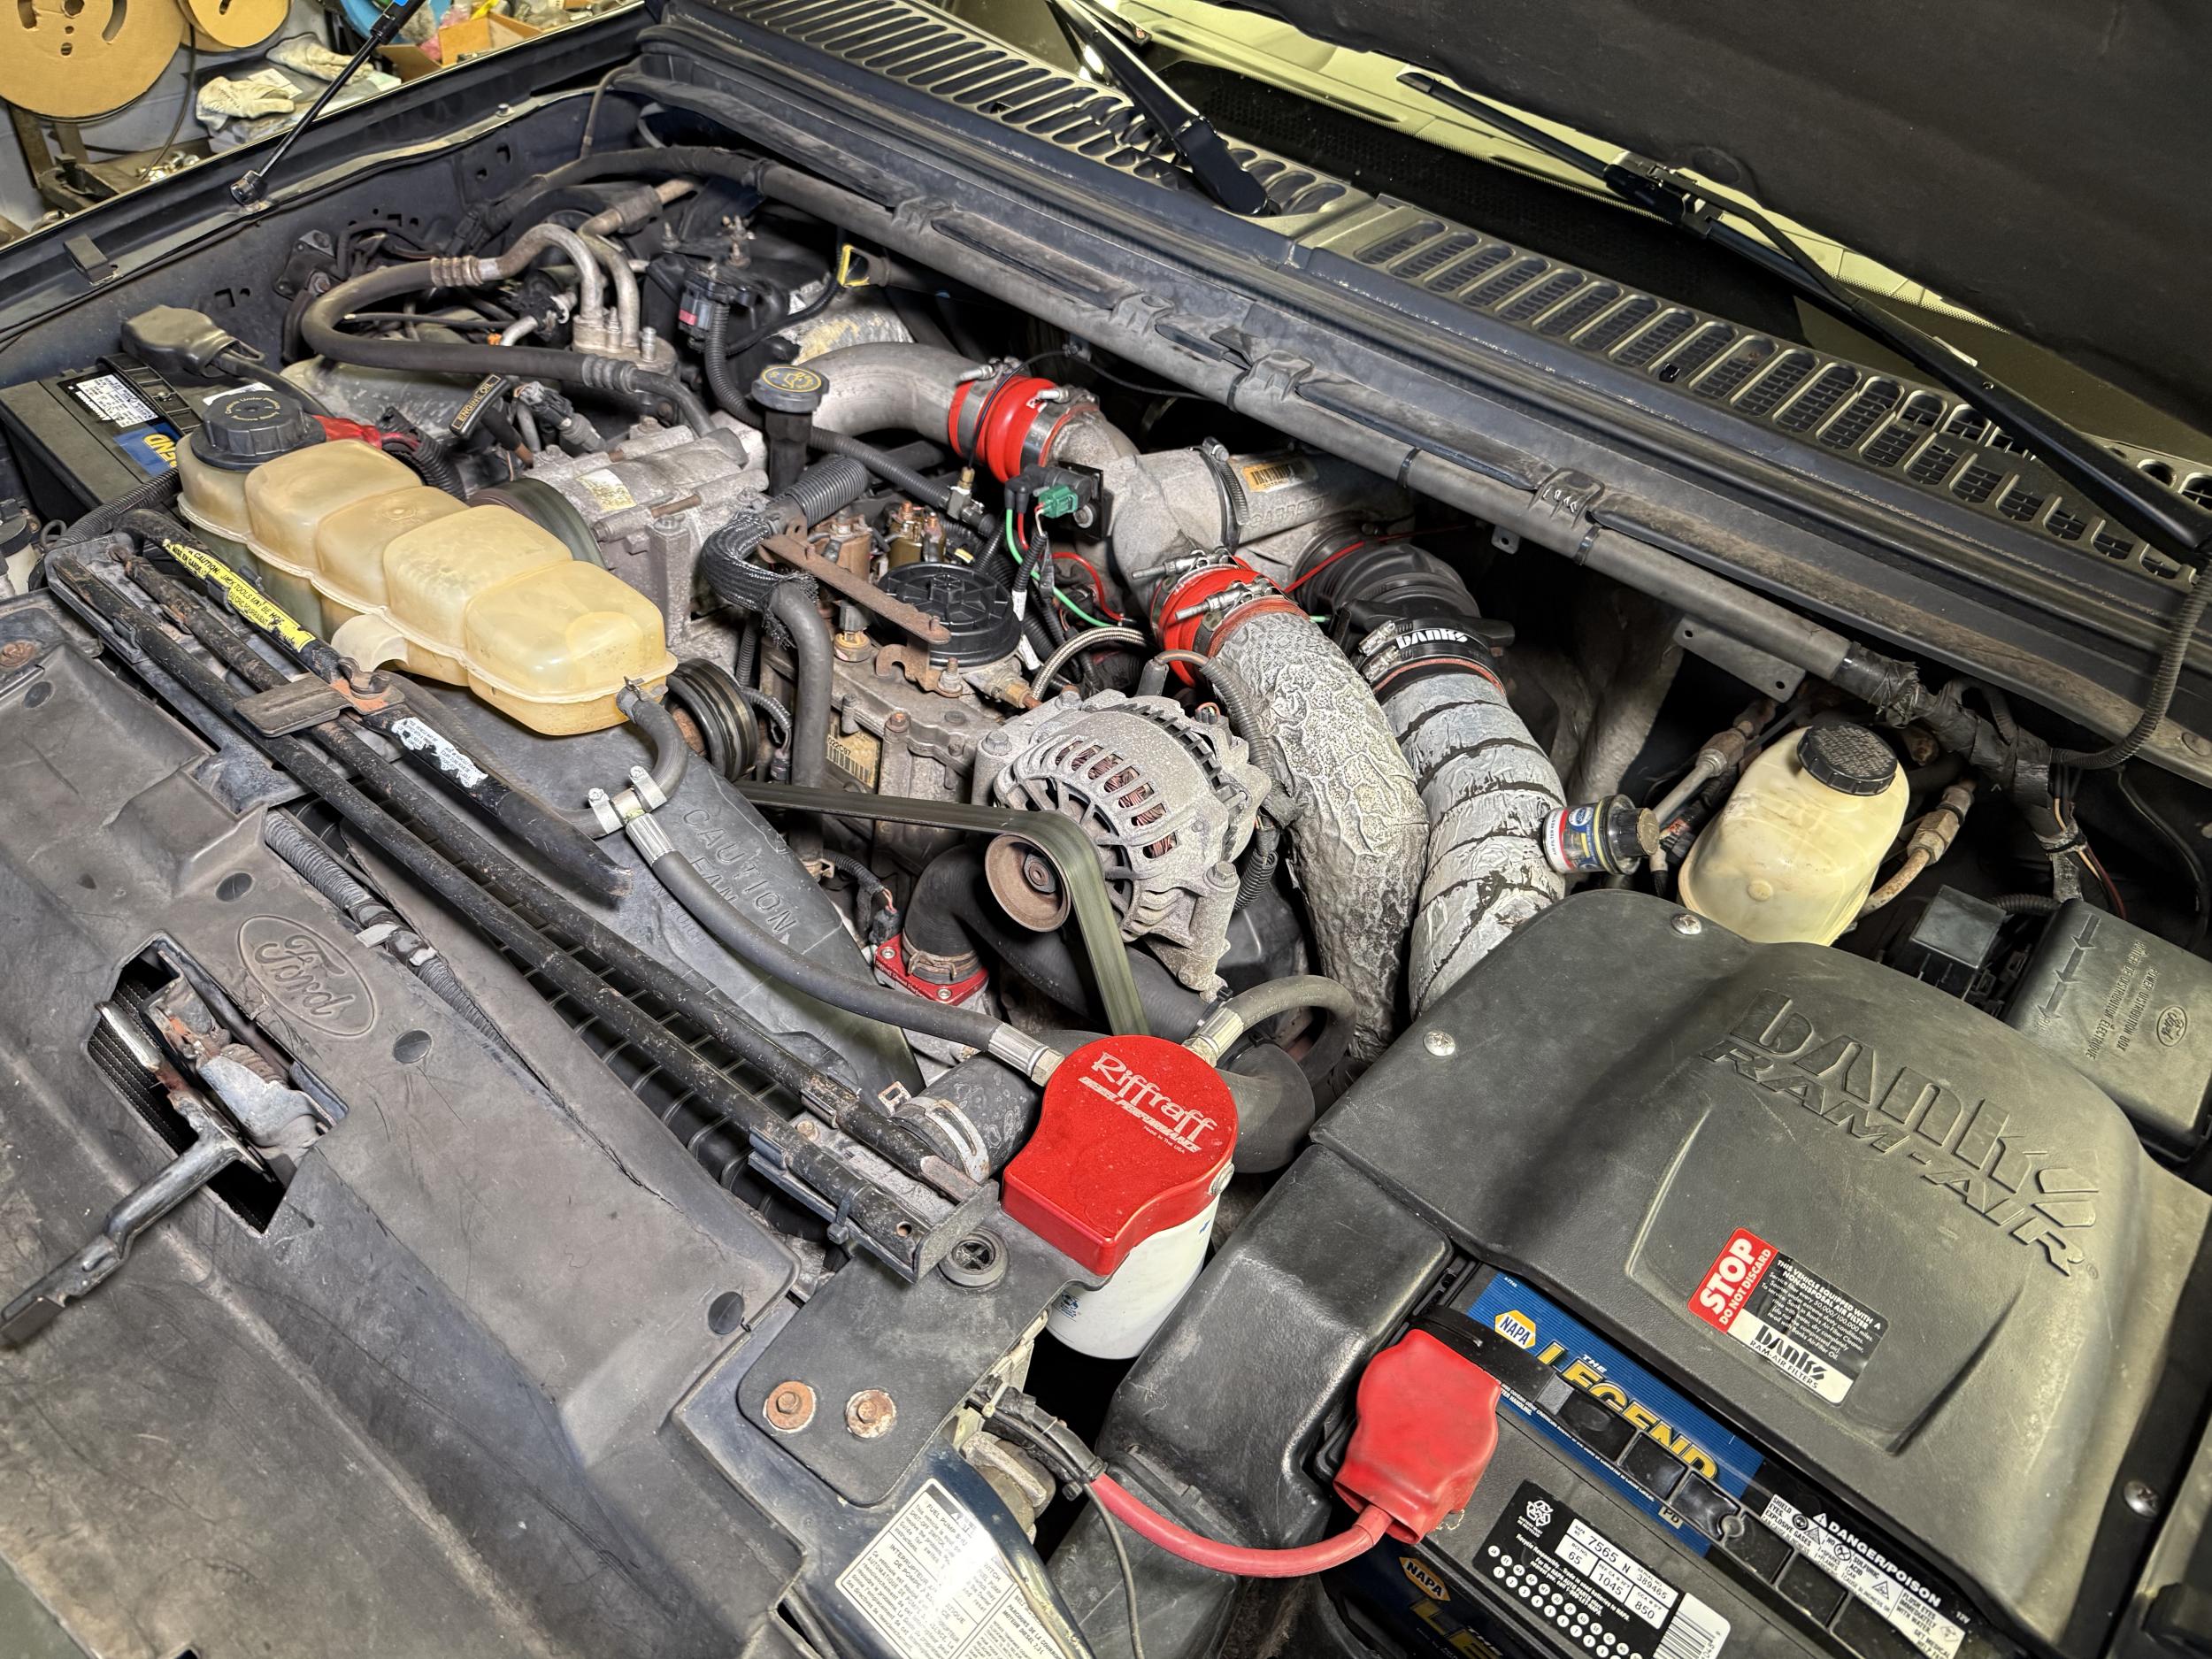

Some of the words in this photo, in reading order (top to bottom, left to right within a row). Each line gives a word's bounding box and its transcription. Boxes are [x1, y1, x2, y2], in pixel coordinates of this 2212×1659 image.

[480, 382, 495, 396] OIL
[220, 572, 234, 588] JACK
[234, 582, 251, 600] TOOLS
[261, 603, 270, 615] BE
[683, 809, 797, 934] CAUTION
[254, 934, 355, 1016] Ford
[2140, 966, 2162, 992] POWER
[2101, 975, 2131, 1018] DISTRIBUTION
[2119, 990, 2151, 1035] DISTRIBUTION
[2160, 1010, 2185, 1041] Ford
[2114, 1034, 2131, 1051] BOX
[1091, 1051, 1218, 1141] Riffraff
[1174, 1142, 1186, 1154] USA
[1699, 1039, 2086, 1277] RAM-AIR
[1699, 1238, 1755, 1315] STOP
[1719, 1309, 1731, 1325] DO
[1728, 1287, 1747, 1309] NOT
[1740, 1248, 1771, 1289] DISCARD
[1768, 1271, 1788, 1286] Service
[1797, 1291, 1814, 1304] every
[1812, 1299, 1860, 1333] 50,000/100,000
[1776, 1258, 1793, 1272] THIS
[1791, 1269, 1819, 1290] VEHICLE
[1818, 1286, 1854, 1312] EQUIPPED
[1852, 1307, 1874, 1324] WITH
[1873, 1322, 1881, 1331] A
[1780, 1271, 1835, 1308] NON-DISPOSAL
[1832, 1303, 1847, 1315] AIR
[1845, 1311, 1869, 1330] FILTER
[1786, 1291, 1803, 1304] under
[1801, 1301, 1824, 1317] extreme
[1822, 1313, 1838, 1326] dusty
[1499, 1315, 1532, 1346] NAPA
[1784, 1305, 1796, 1316] with
[1809, 1323, 1821, 1333] dry
[1819, 1329, 1850, 1352] completely
[1791, 1326, 1808, 1340] Banks
[1805, 1310, 1822, 1325] Banks
[1799, 1324, 1831, 1347] compressed
[1582, 1354, 1608, 1373] THE
[1749, 1340, 1786, 1368] RAM-AIR
[1787, 1364, 1818, 1389] FILTERS
[1508, 1395, 1533, 1416] HANDLING.
[1535, 1340, 1718, 1480] LEGEND
[926, 1502, 941, 1519] FUEL
[939, 1517, 956, 1534] PUMP
[1771, 1496, 1793, 1514] SHIELD
[899, 1520, 913, 1535] Guide
[1764, 1509, 1793, 1533] EXPLOSIVE
[1793, 1530, 1812, 1547] GASES
[1825, 1536, 1835, 1546] NO
[888, 1543, 929, 1586] INTERRUPTEUR
[1567, 1551, 1583, 1565] 65
[1586, 1535, 1619, 1563] 7565
[1828, 1521, 1941, 1608] DANGER/POISON
[866, 1555, 899, 1589] AUTOMATIQUE
[896, 1587, 905, 1596] DE
[893, 1558, 903, 1569] DE
[900, 1567, 922, 1589] POMPE
[1406, 1561, 1442, 1597] NAPA
[1515, 1532, 1534, 1550] Recycle
[1578, 1580, 1593, 1593] used
[1590, 1588, 1611, 1607] batteries
[1615, 1607, 1632, 1622] NAPA.
[1534, 1556, 1544, 1566] For
[1549, 1568, 1564, 1581] NAPA
[1563, 1578, 1577, 1590] AUTO
[1575, 1586, 1592, 1601] PARTS
[1621, 1563, 1631, 1573] N
[1842, 1575, 1858, 1588] CAUSE
[1845, 1569, 1857, 1579] CAN
[1848, 1563, 1863, 1576] ACID
[1852, 1555, 1880, 1578] SULFURIC
[1596, 1572, 1624, 1595] 1045
[1636, 1573, 1668, 1600] 389465
[1637, 1591, 1648, 1601] CCA
[1005, 1602, 1031, 1628] PARCOURS
[1027, 1625, 1035, 1634] DE
[1633, 1600, 1656, 1619] 850
[1894, 1605, 1911, 1618] WITH
[1898, 1599, 1936, 1629] IMMEDIATELY
[1901, 1592, 1922, 1609] FLUSH
[1920, 1605, 1937, 1620] EYES
[1955, 1610, 1970, 1624] 12V
[1001, 1609, 1020, 1629] MOTEUR
[1018, 1627, 1034, 1644] DIESEL
[1924, 1636, 1951, 1659] MEDICAL
